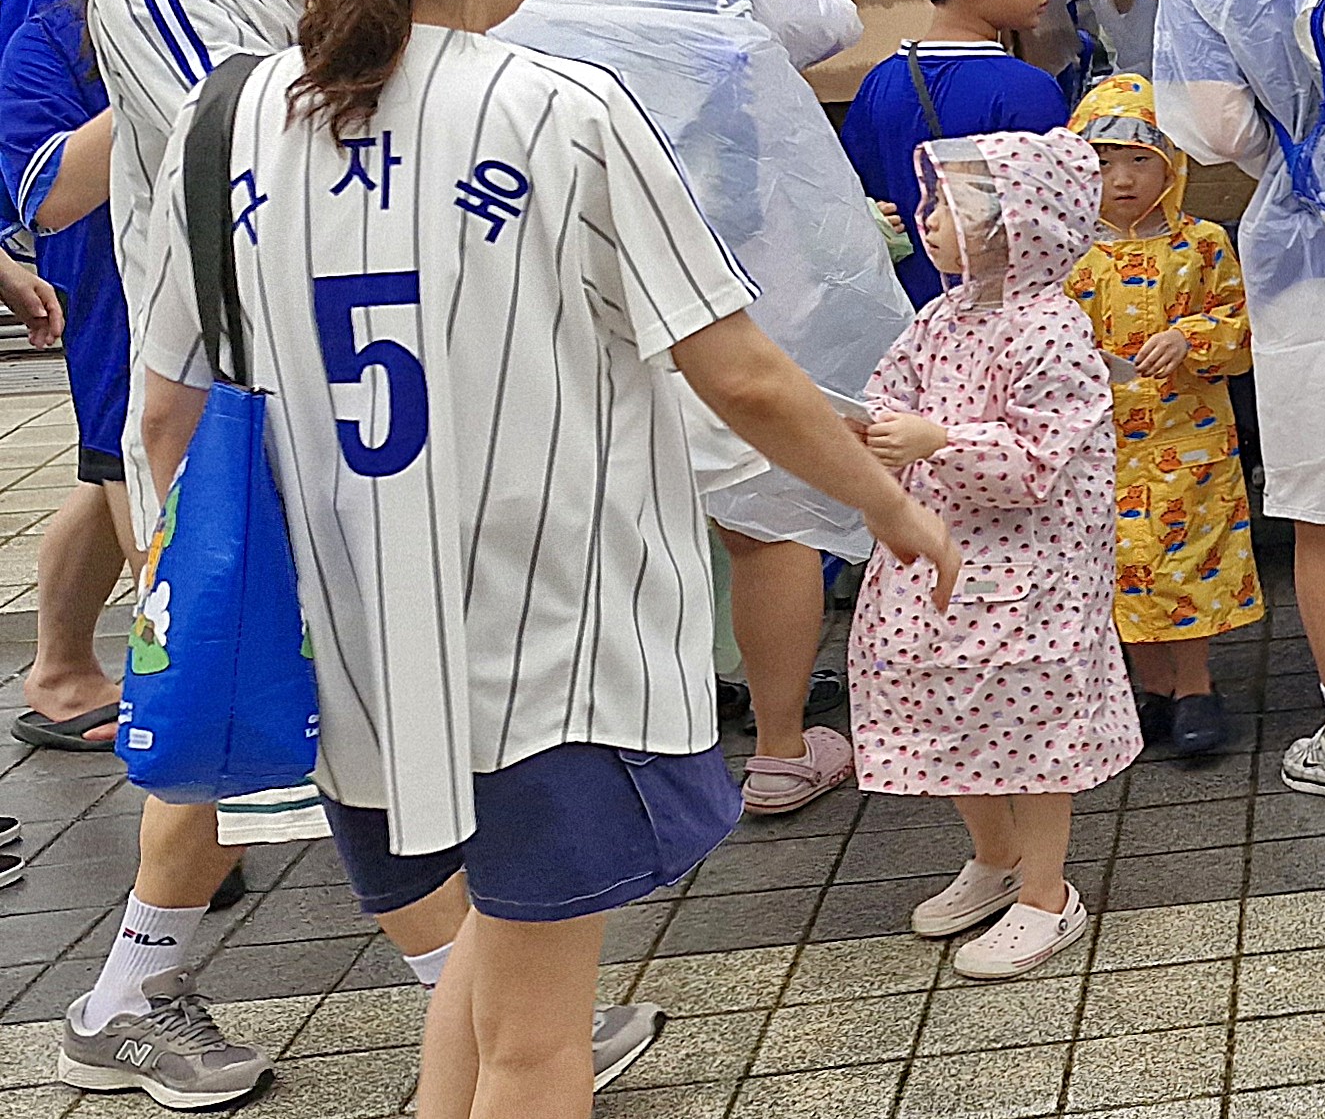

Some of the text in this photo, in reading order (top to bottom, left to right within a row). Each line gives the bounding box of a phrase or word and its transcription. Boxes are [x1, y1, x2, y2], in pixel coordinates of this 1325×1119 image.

[313, 270, 430, 478] 5
[122, 927, 177, 947] FILA
[115, 1039, 153, 1067] N
